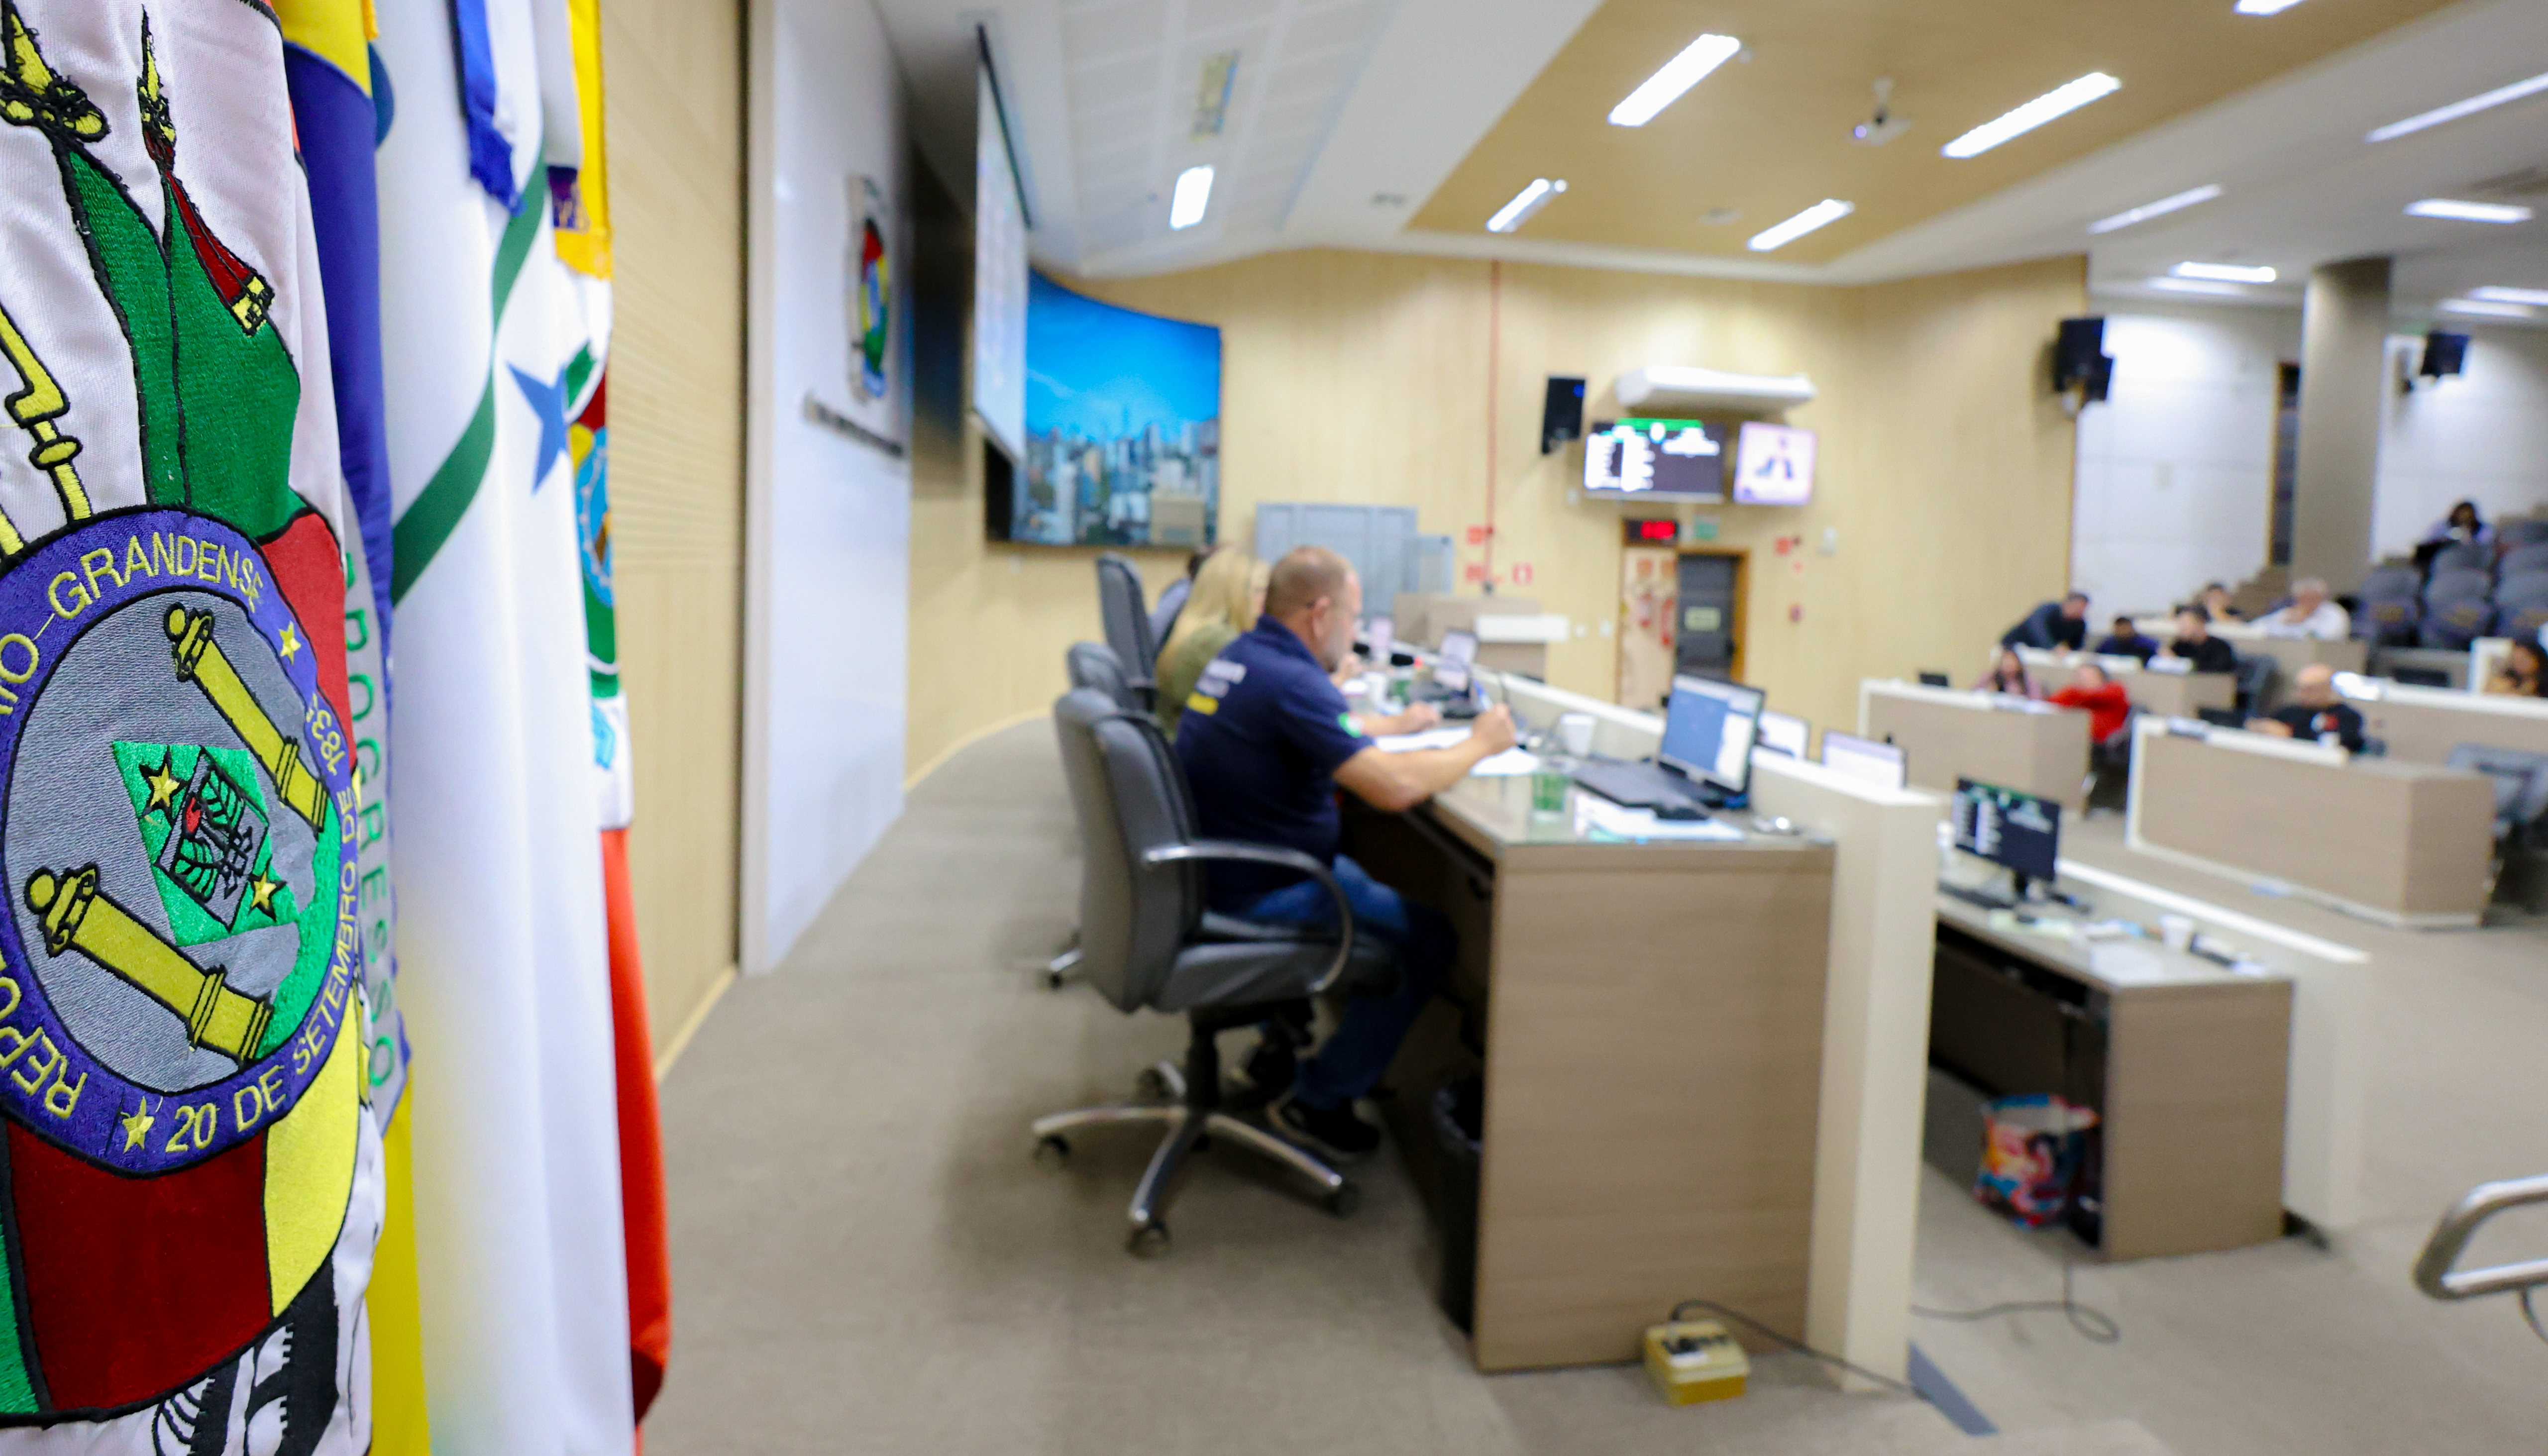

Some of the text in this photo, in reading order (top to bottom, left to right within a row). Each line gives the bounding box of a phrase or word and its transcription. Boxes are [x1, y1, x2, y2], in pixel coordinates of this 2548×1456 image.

[165, 1103, 218, 1152] 20
[233, 1064, 286, 1132] DE
[292, 861, 356, 1075] SETEMBRO
[336, 786, 356, 844] DE
[345, 551, 395, 1087] ROGRESSO
